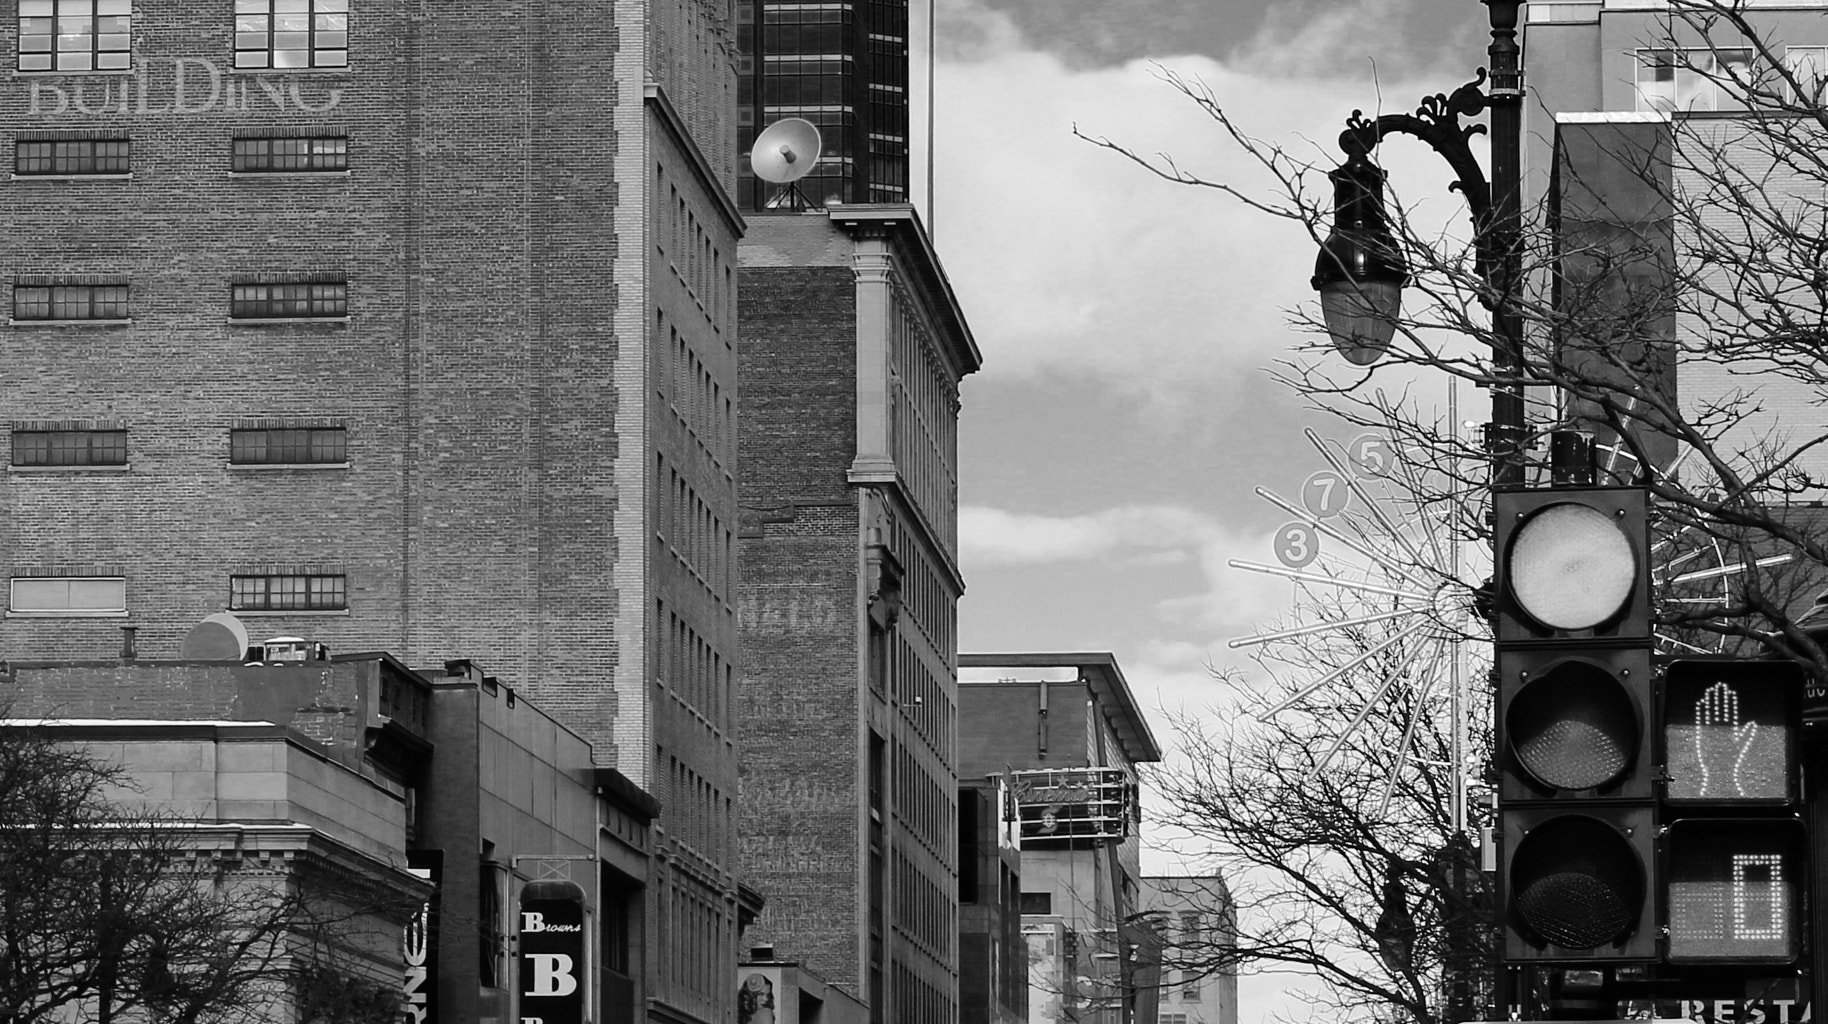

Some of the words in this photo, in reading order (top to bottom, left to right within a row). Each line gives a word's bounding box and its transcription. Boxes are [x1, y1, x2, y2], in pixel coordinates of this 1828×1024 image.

[27, 57, 342, 115] BUILDING
[1360, 441, 1384, 474] 5
[1313, 478, 1336, 511] 7
[1284, 528, 1309, 563] 3
[1732, 854, 1783, 940] 0
[520, 911, 581, 933] Browns
[525, 953, 577, 997] B
